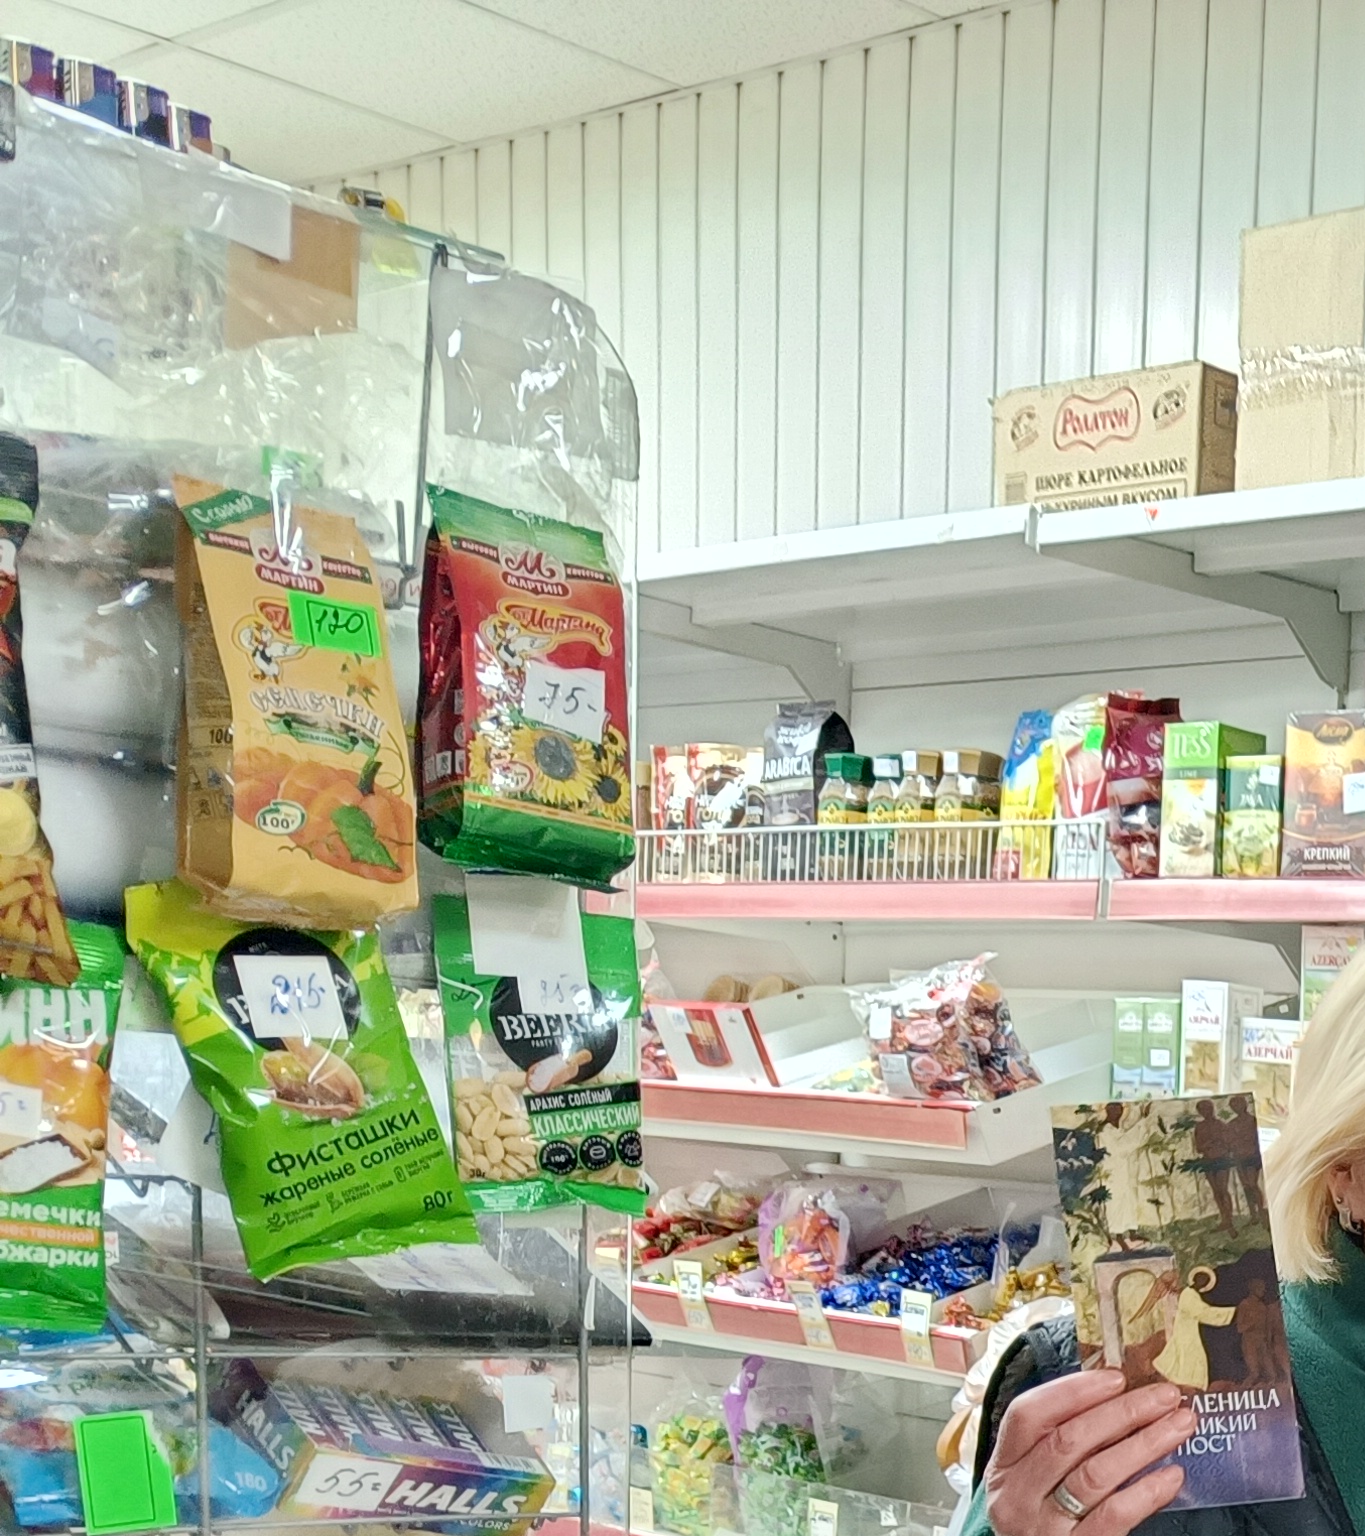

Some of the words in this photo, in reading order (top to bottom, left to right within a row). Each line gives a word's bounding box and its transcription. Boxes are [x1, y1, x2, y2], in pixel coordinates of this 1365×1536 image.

[507, 574, 564, 596] МАРТИН
[1174, 732, 1211, 757] TESS
[764, 755, 812, 781] ARABICA
[1303, 846, 1350, 861] КРЕПКИЙ
[530, 1095, 565, 1111] АРАХИС
[568, 1088, 612, 1108] СОЛЁНЫЙ
[532, 1105, 640, 1138] КЛАССИЧЕСКИЙ
[266, 1109, 420, 1178] Фисташки
[260, 1161, 356, 1208] жареные
[361, 1127, 439, 1169] солёные
[1177, 1434, 1235, 1456] ПОСТ
[385, 1480, 527, 1516] HALLS
